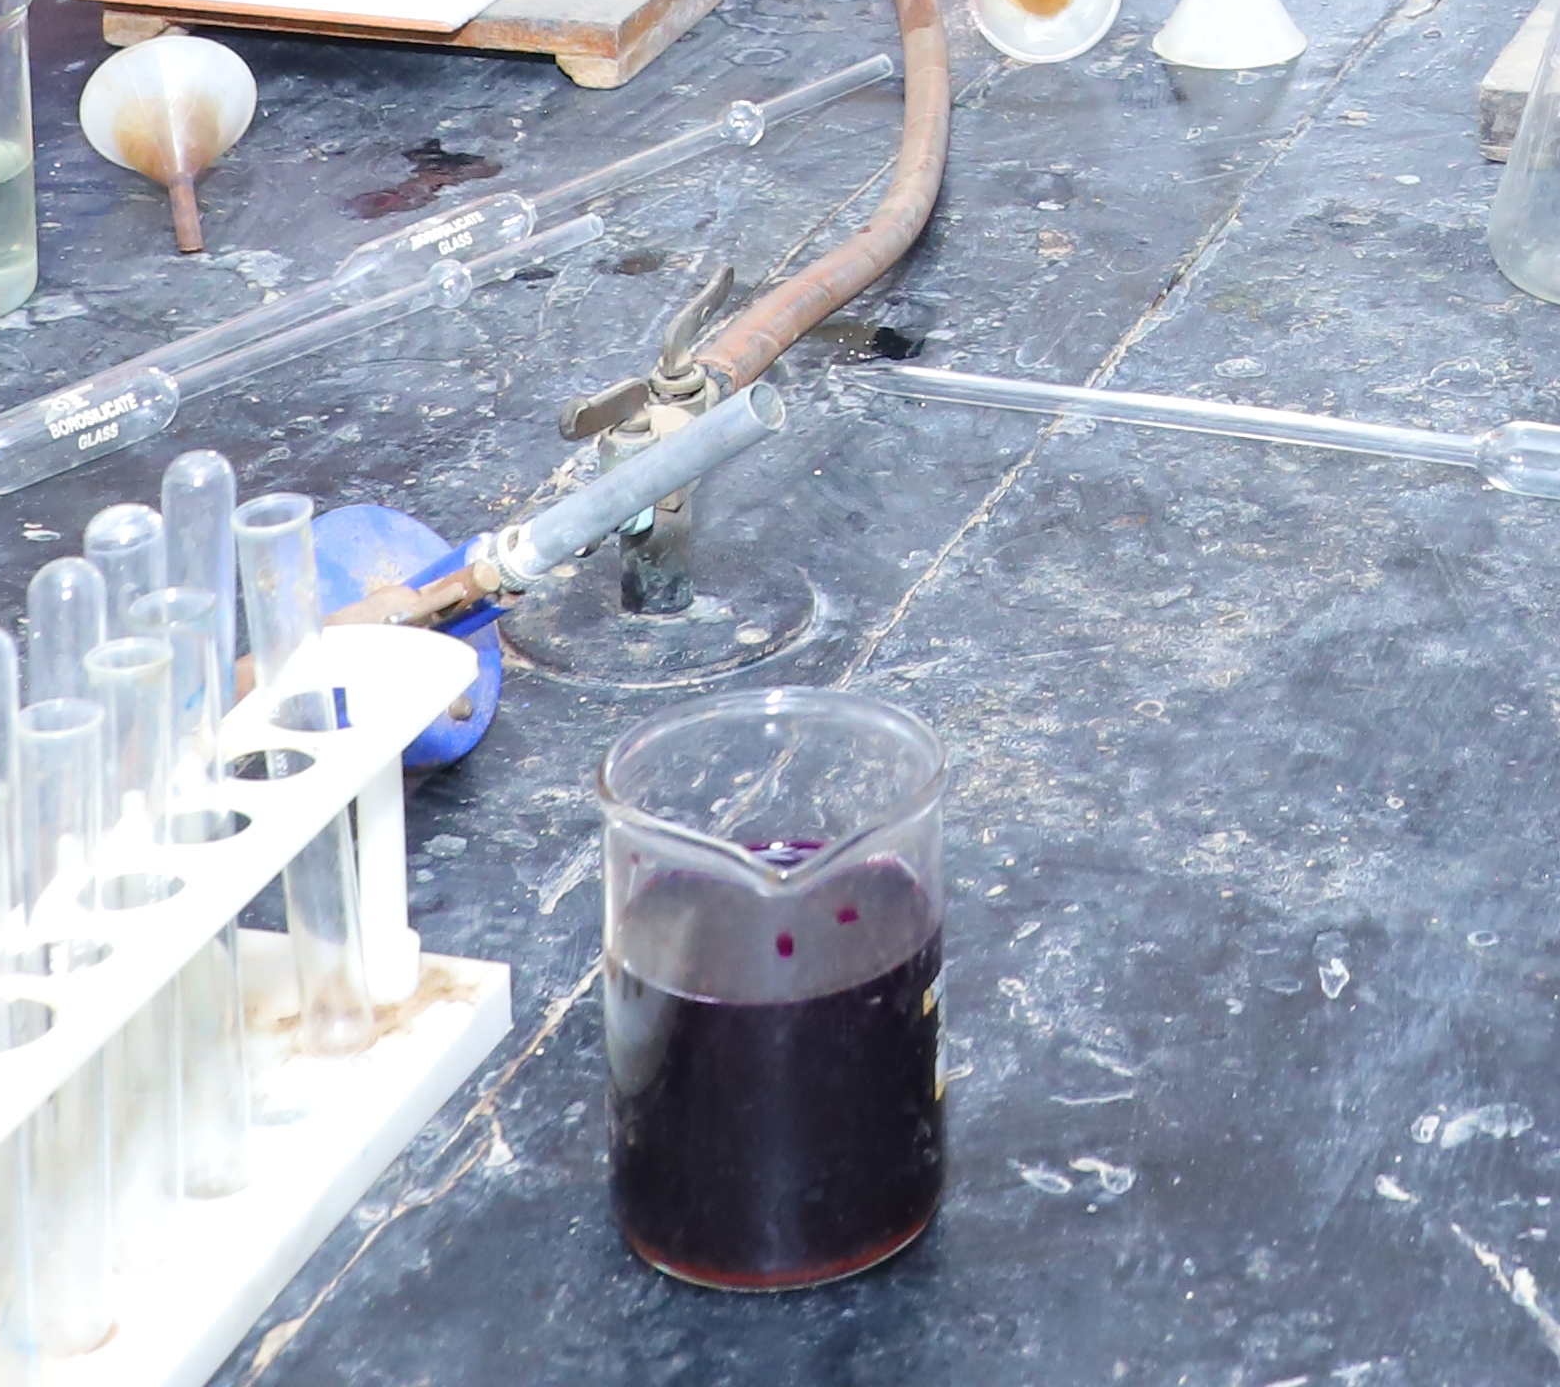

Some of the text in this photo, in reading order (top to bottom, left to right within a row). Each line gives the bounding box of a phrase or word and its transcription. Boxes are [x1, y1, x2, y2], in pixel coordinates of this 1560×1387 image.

[438, 231, 473, 256] GLASS
[48, 391, 139, 440] BOROSILICATE
[78, 421, 119, 451] GLASS
